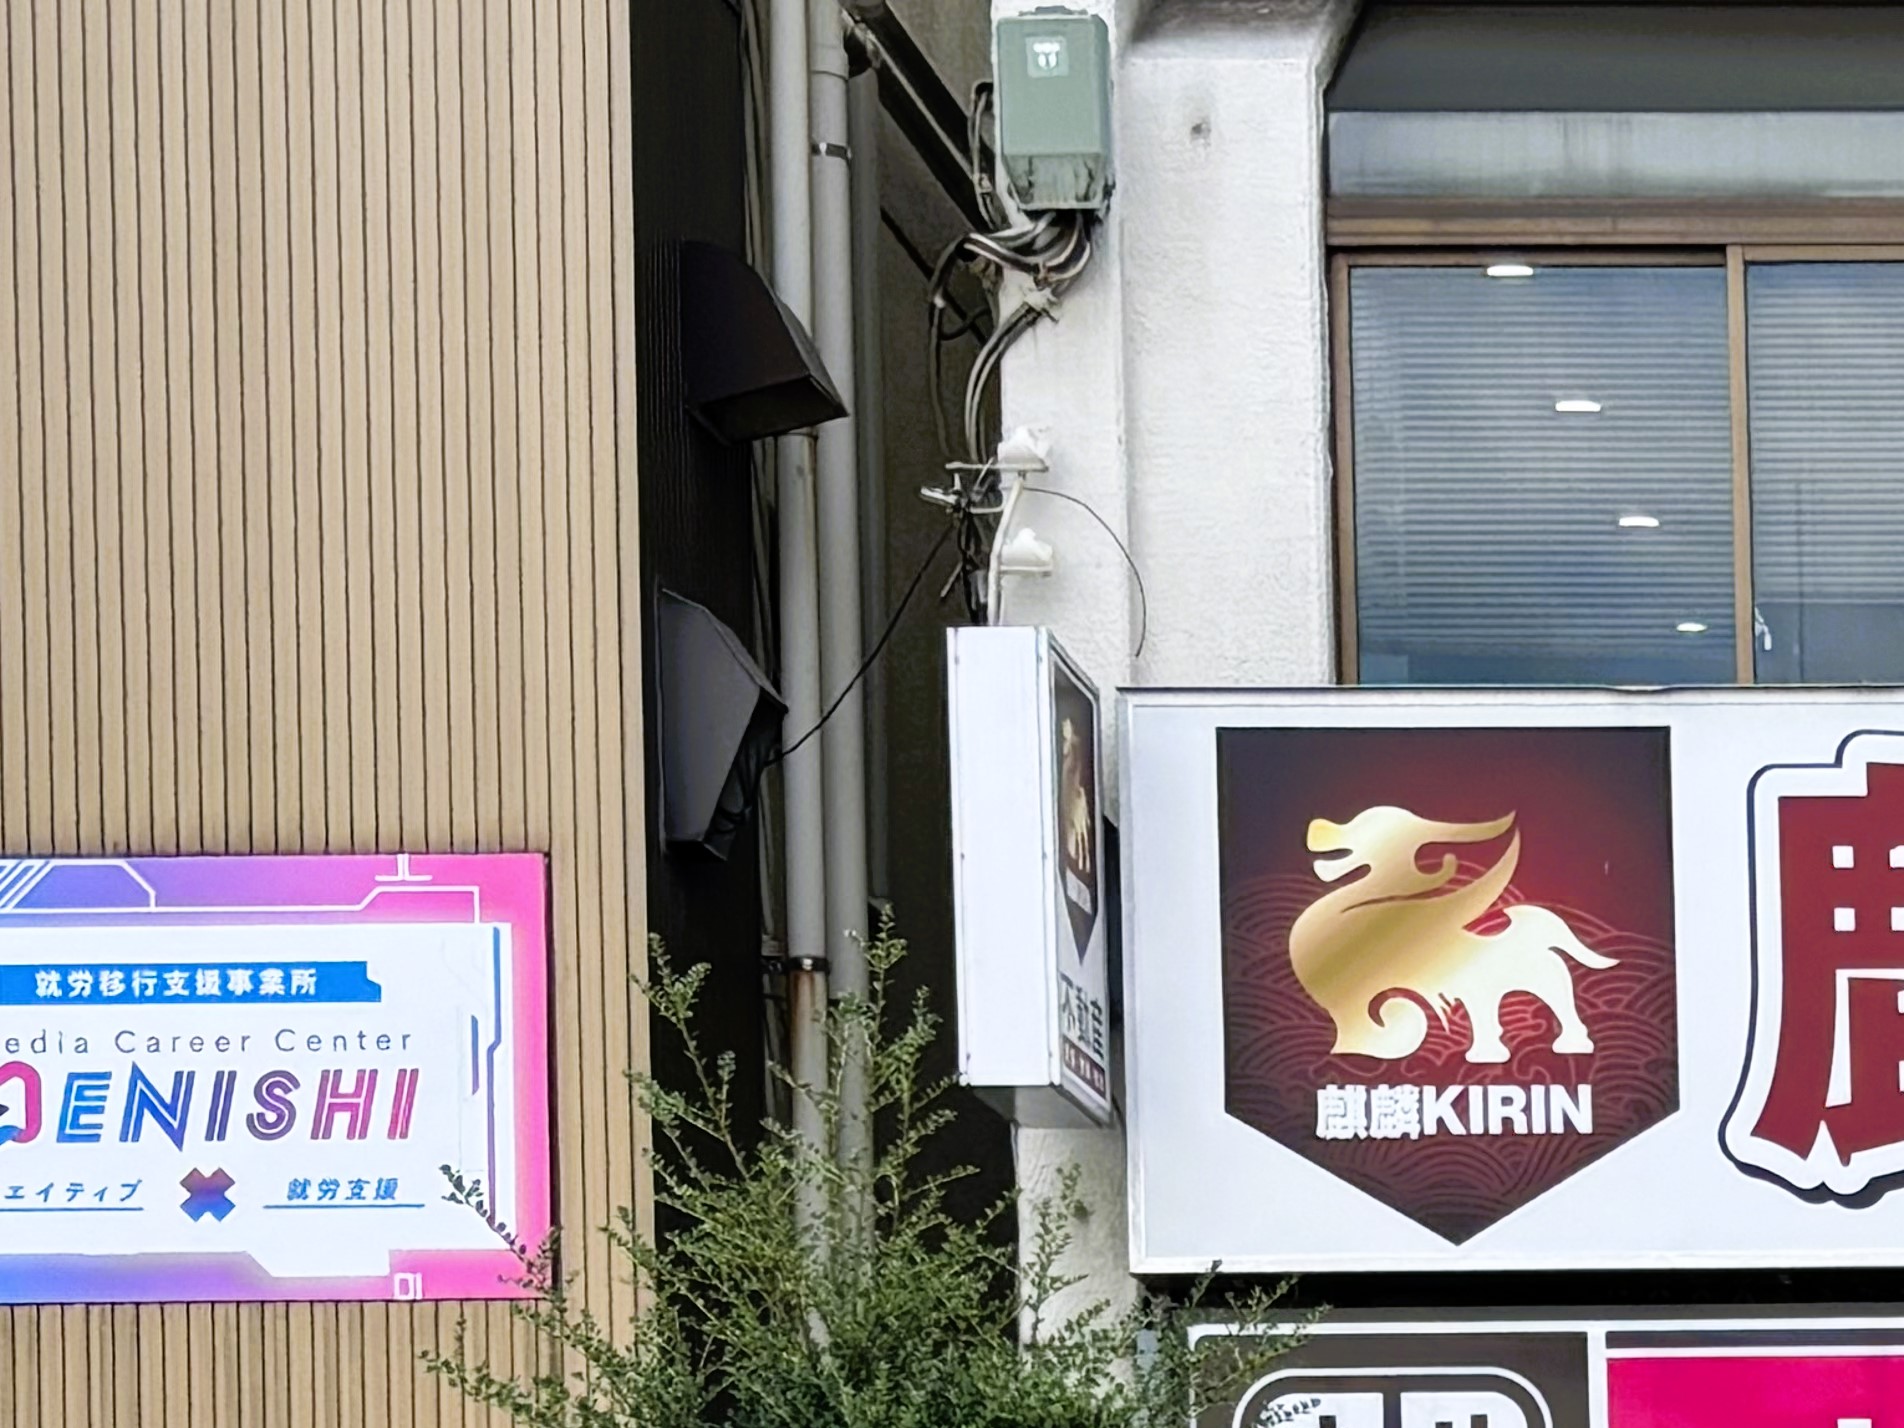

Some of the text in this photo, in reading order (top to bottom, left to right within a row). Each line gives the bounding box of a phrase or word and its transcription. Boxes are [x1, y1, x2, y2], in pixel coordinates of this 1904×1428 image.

[34, 967, 319, 999] 就労移行支援事業所
[114, 1029, 252, 1054] Career
[274, 1028, 412, 1052] Center
[286, 1177, 400, 1202] 就労支援
